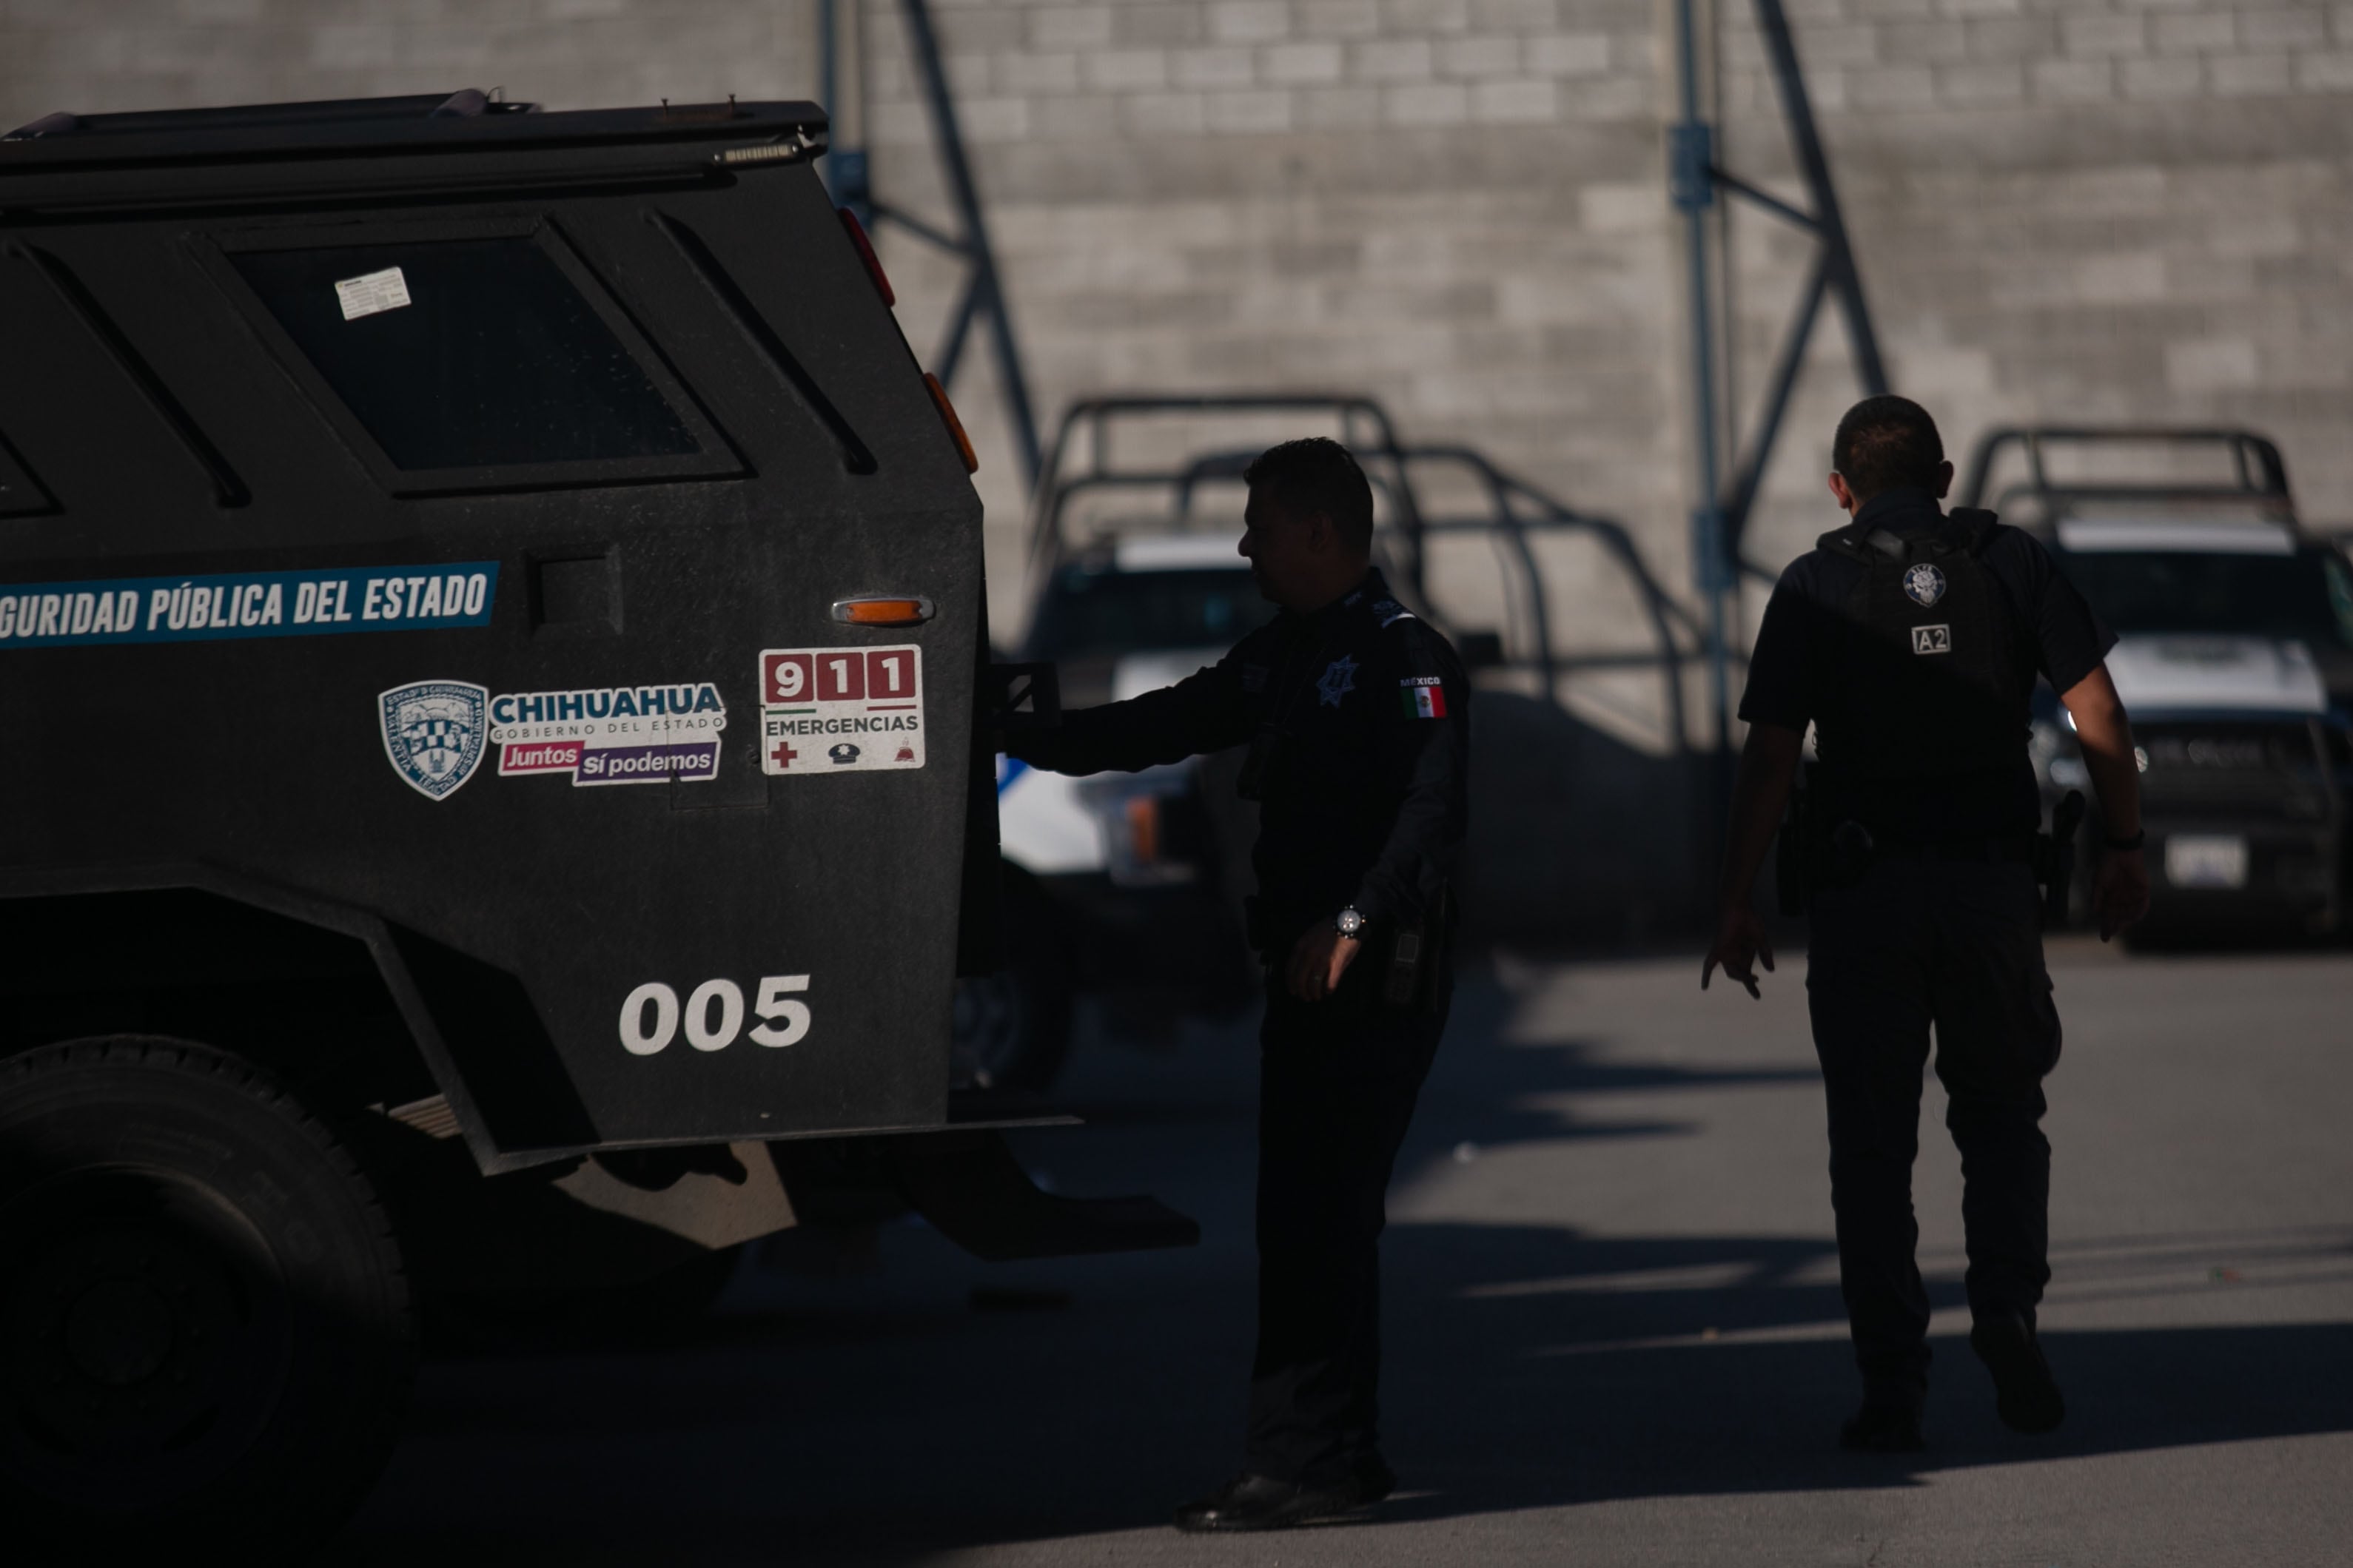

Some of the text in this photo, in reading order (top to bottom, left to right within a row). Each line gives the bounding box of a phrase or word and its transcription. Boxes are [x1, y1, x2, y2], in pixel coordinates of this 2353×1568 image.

[147, 581, 283, 630] PÚBLICA
[293, 580, 352, 623] DEL
[362, 573, 487, 620] ESTADO
[1919, 629, 1947, 651] A2
[493, 687, 721, 723] CHIHUAHUA
[494, 717, 722, 739] GOBIERNO DEL ESTADO
[766, 716, 919, 736] EMERGENCIAS
[507, 746, 577, 767] Juntos
[609, 750, 711, 778] podemos
[619, 973, 811, 1056] 005
